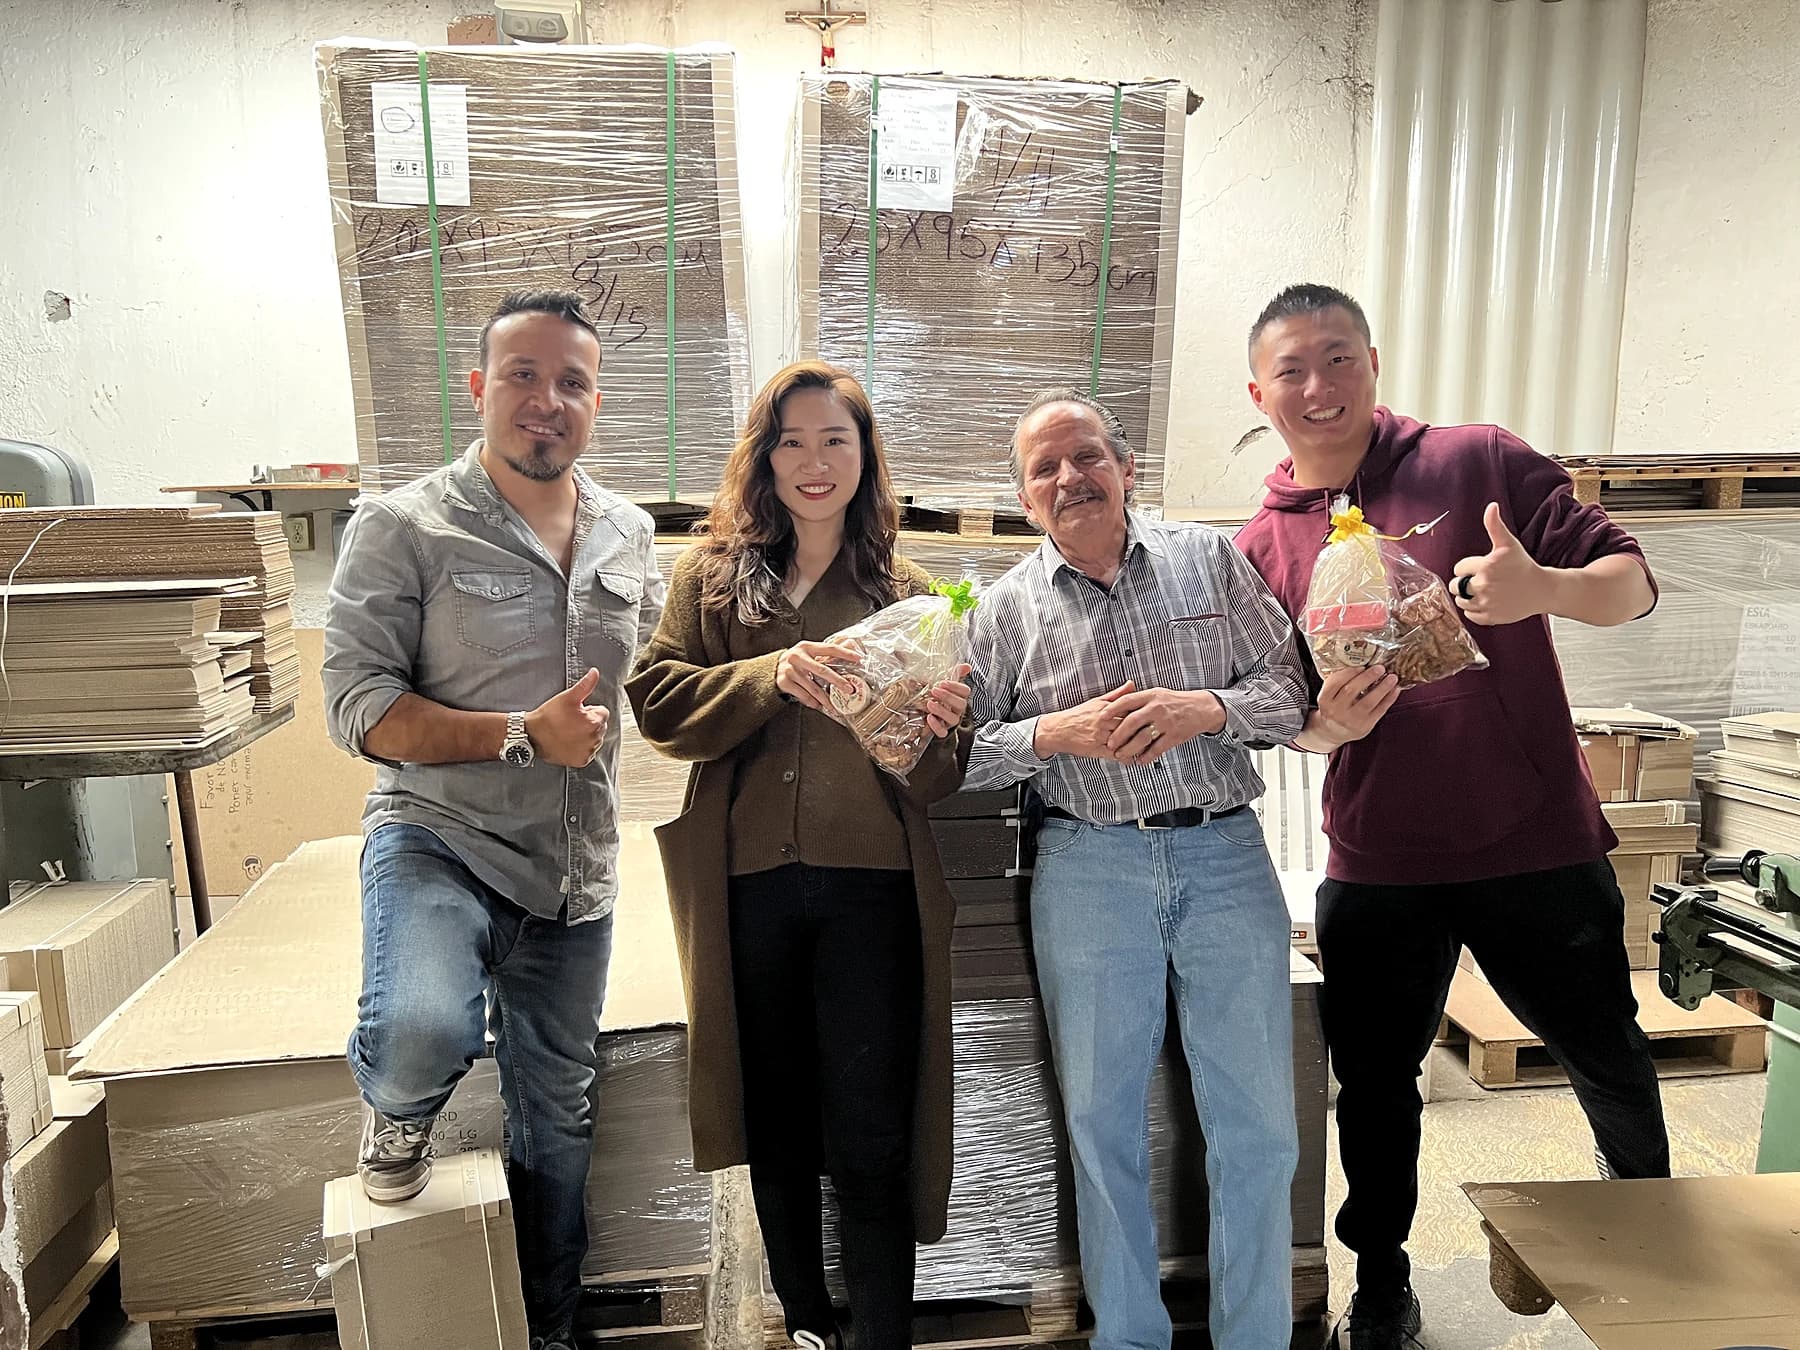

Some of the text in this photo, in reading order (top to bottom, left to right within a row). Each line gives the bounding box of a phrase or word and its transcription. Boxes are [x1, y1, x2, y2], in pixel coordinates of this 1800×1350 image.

[571, 259, 648, 351] 8/15
[200, 772, 216, 809] Favor
[228, 780, 241, 814] Poner
[436, 1111, 458, 1122] RD
[459, 1128, 478, 1140] LG
